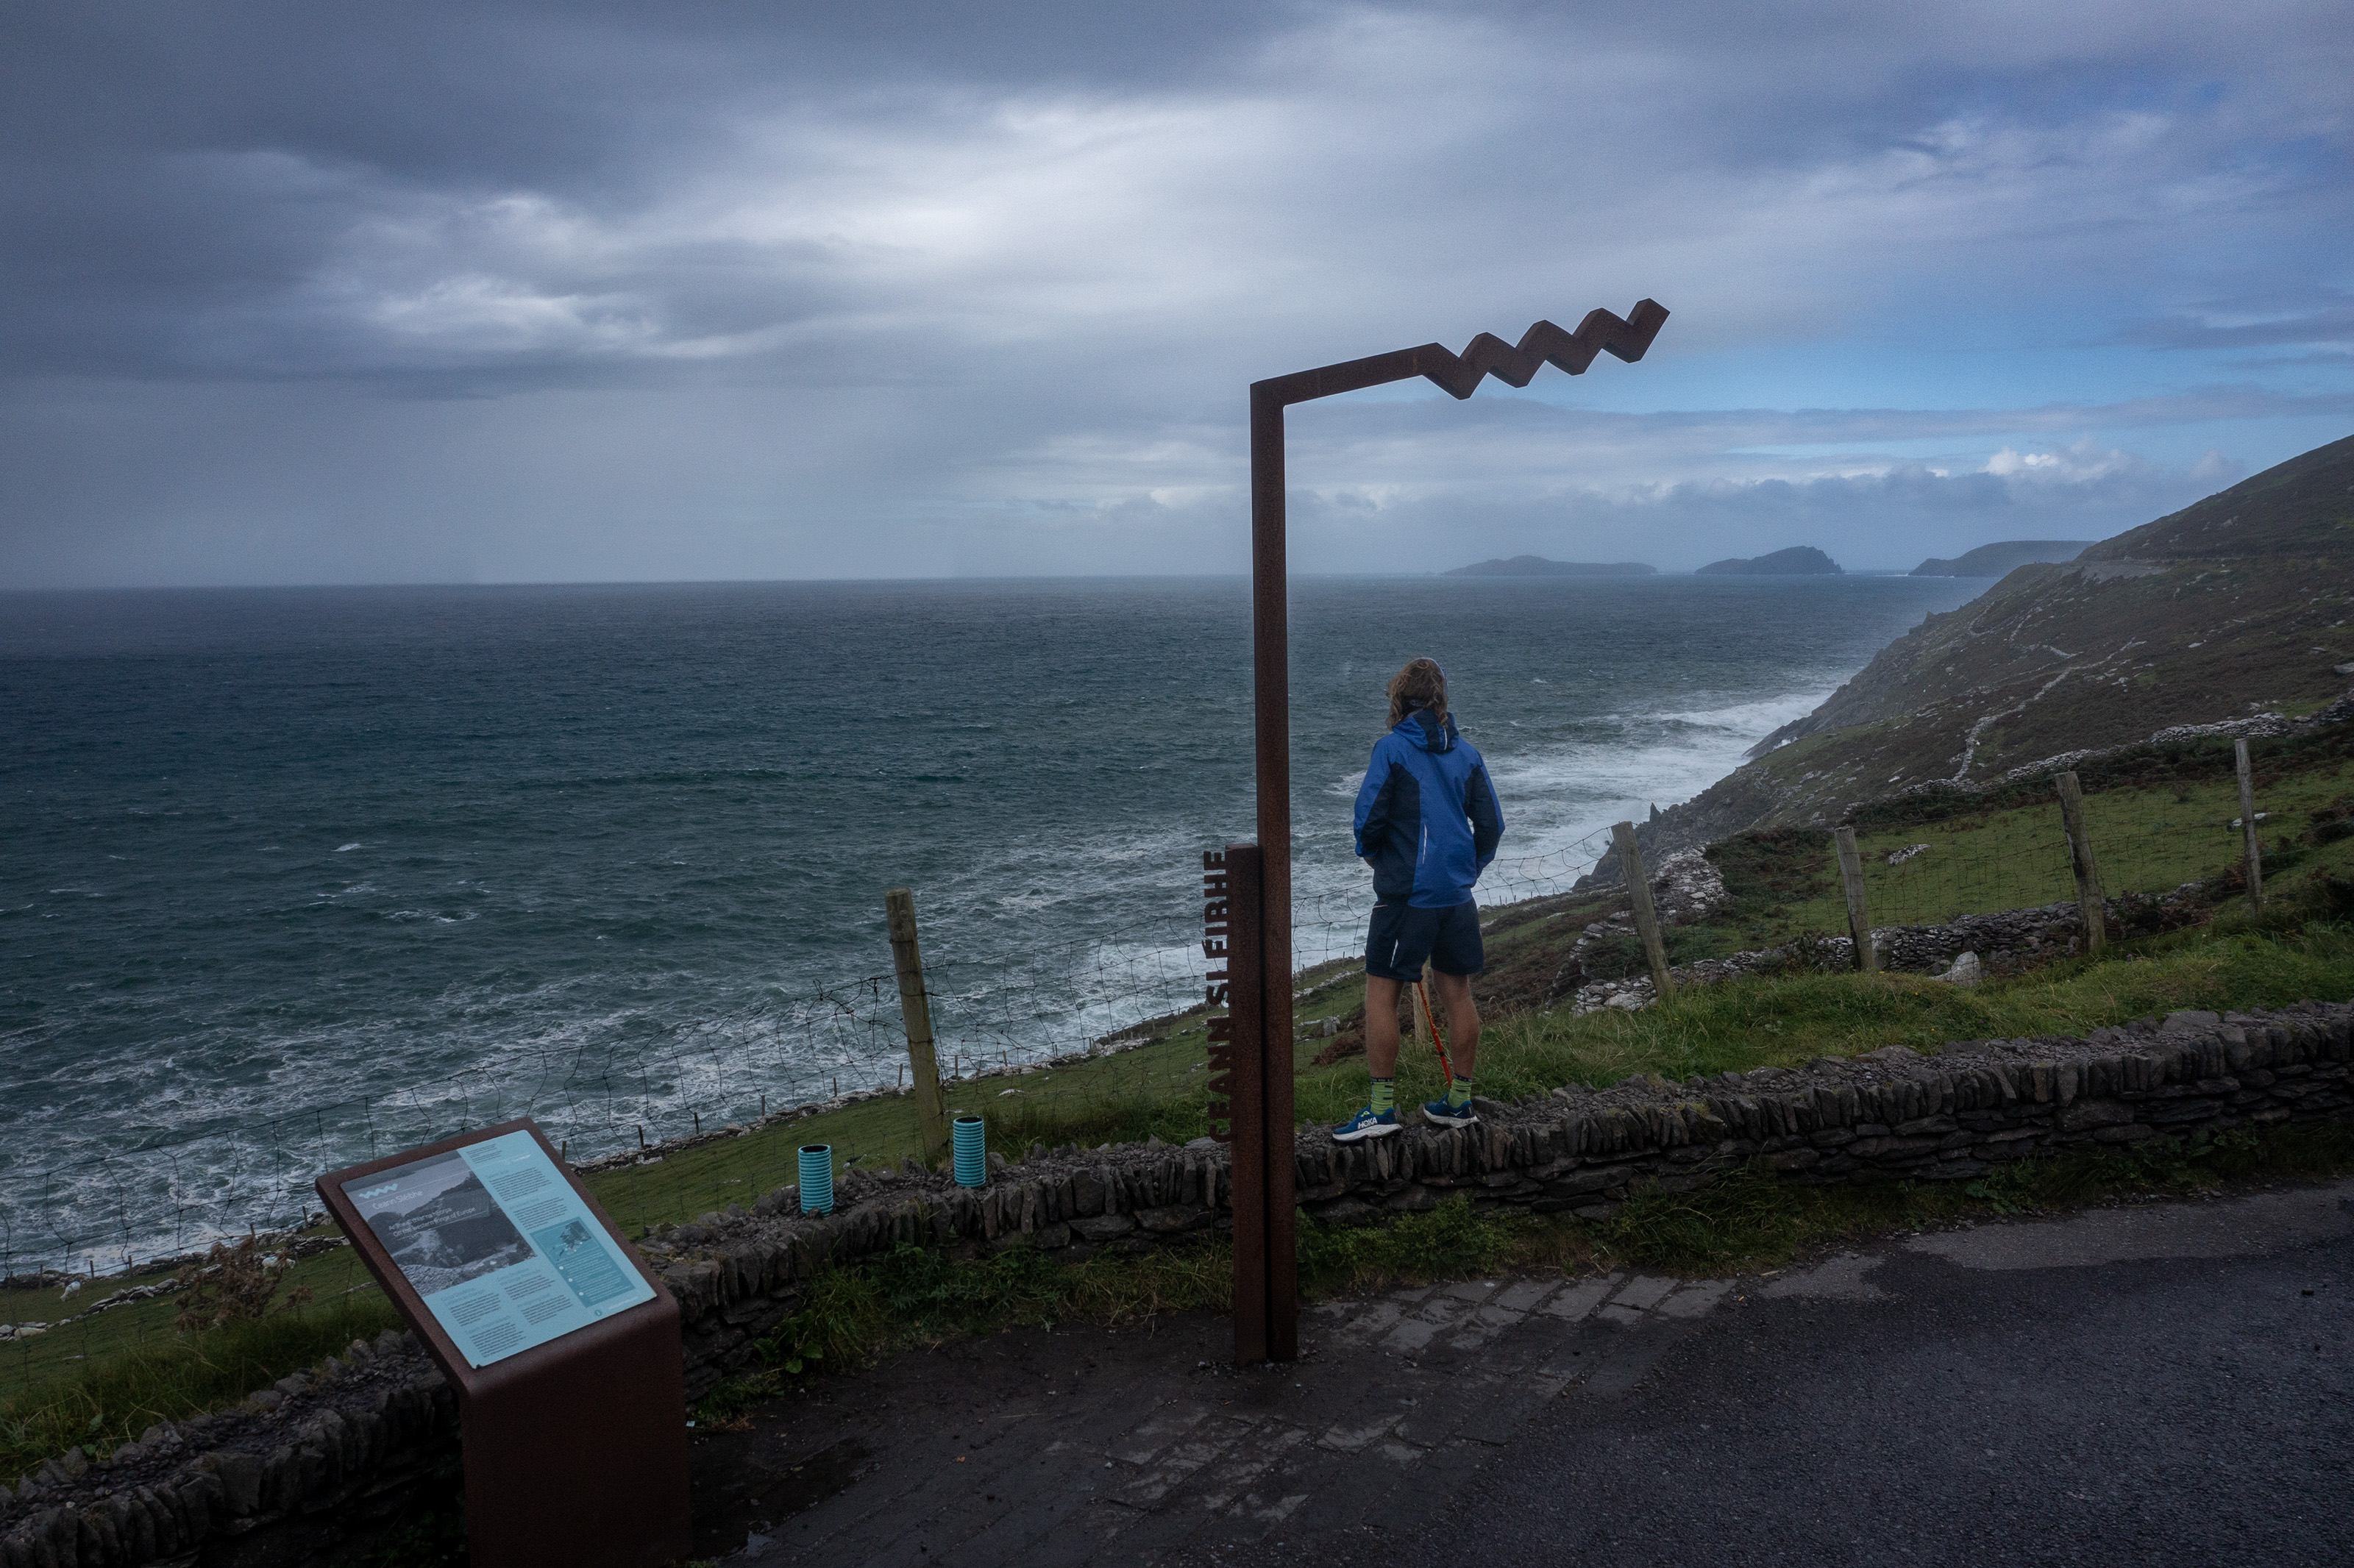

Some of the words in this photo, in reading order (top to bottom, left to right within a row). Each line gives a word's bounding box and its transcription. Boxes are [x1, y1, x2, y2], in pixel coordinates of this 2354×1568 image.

[1206, 1016, 1233, 1144] CEANN
[1357, 1116, 1378, 1130] HOKA
[372, 1198, 397, 1210] Ceann
[396, 1190, 424, 1202] Sléibhe
[412, 1220, 434, 1232] western
[434, 1215, 450, 1226] fringe
[450, 1211, 458, 1219] of
[457, 1206, 476, 1218] Europe
